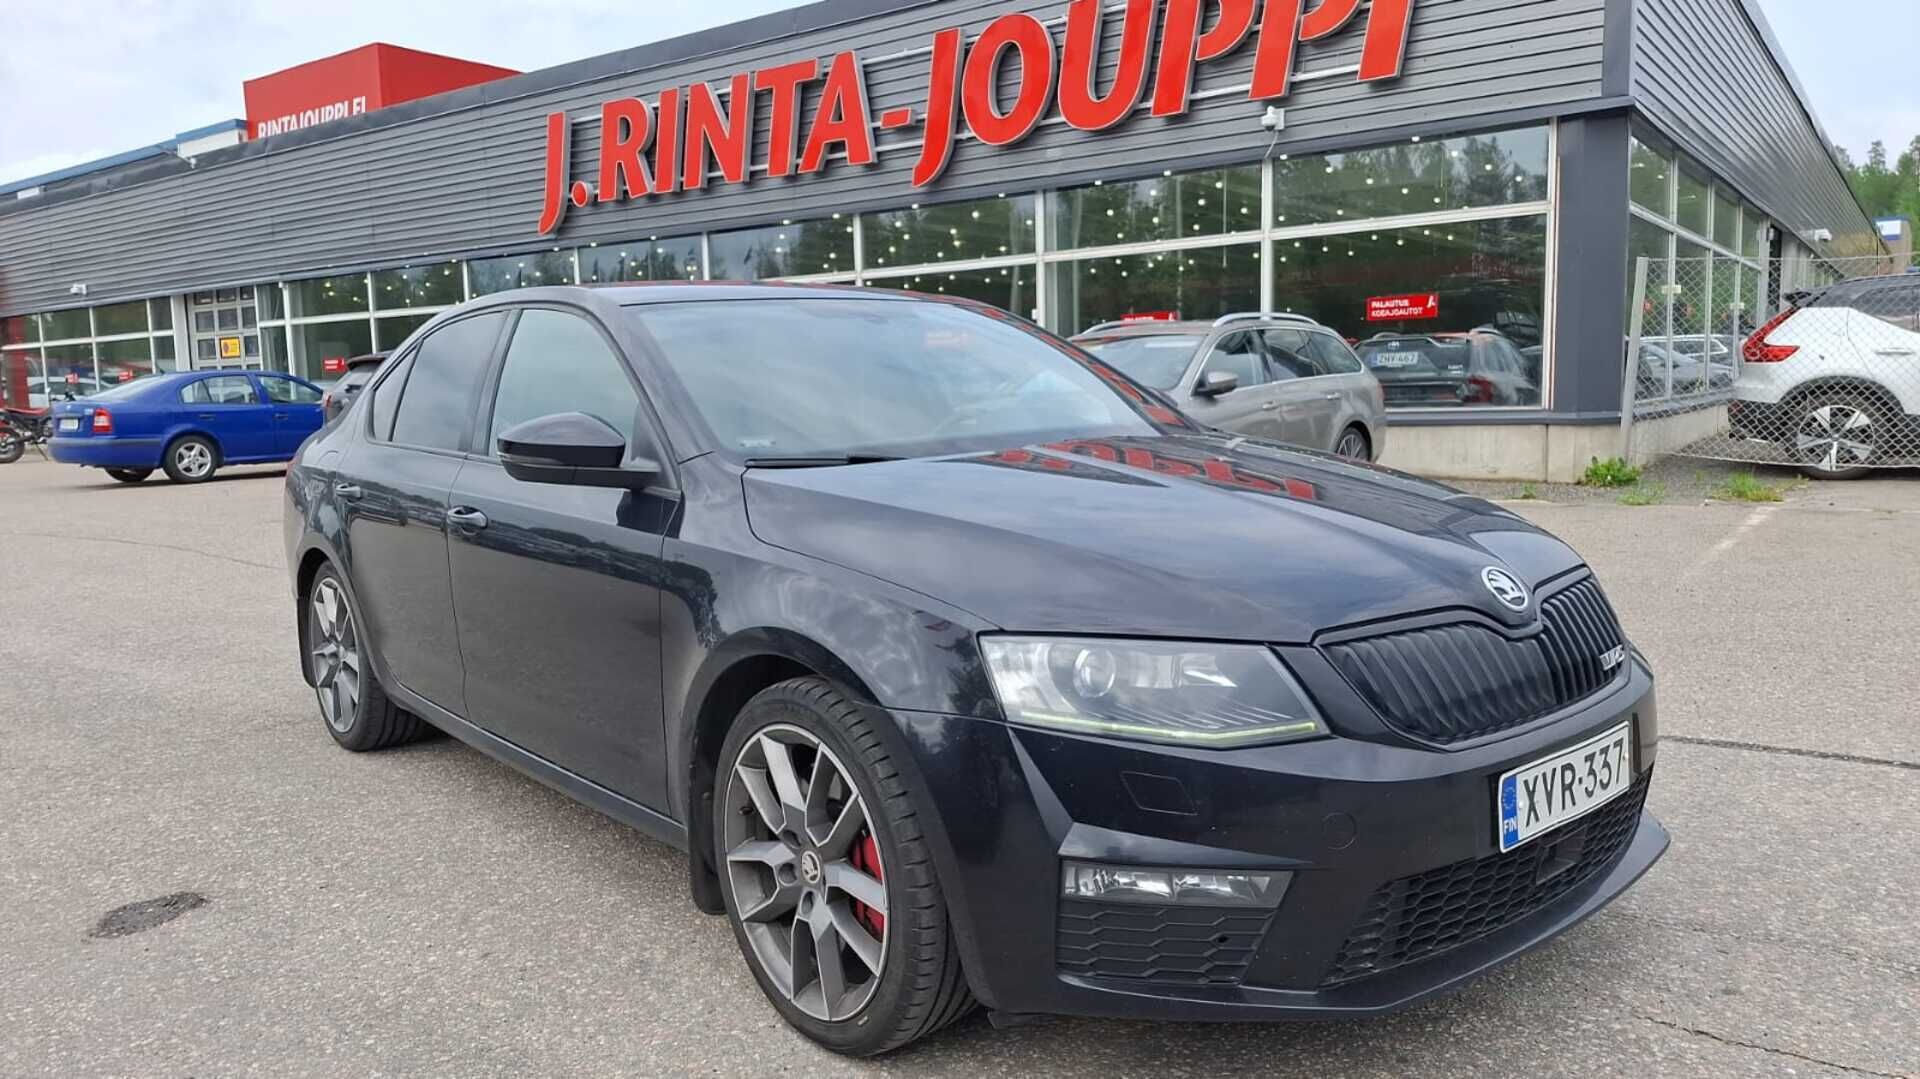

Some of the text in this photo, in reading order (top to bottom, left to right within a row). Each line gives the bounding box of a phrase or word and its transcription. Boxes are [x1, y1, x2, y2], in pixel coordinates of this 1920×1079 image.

[1371, 299, 1409, 308] PALAUTUS
[1523, 737, 1624, 828] XVR-337
[1504, 816, 1517, 834] FIN
